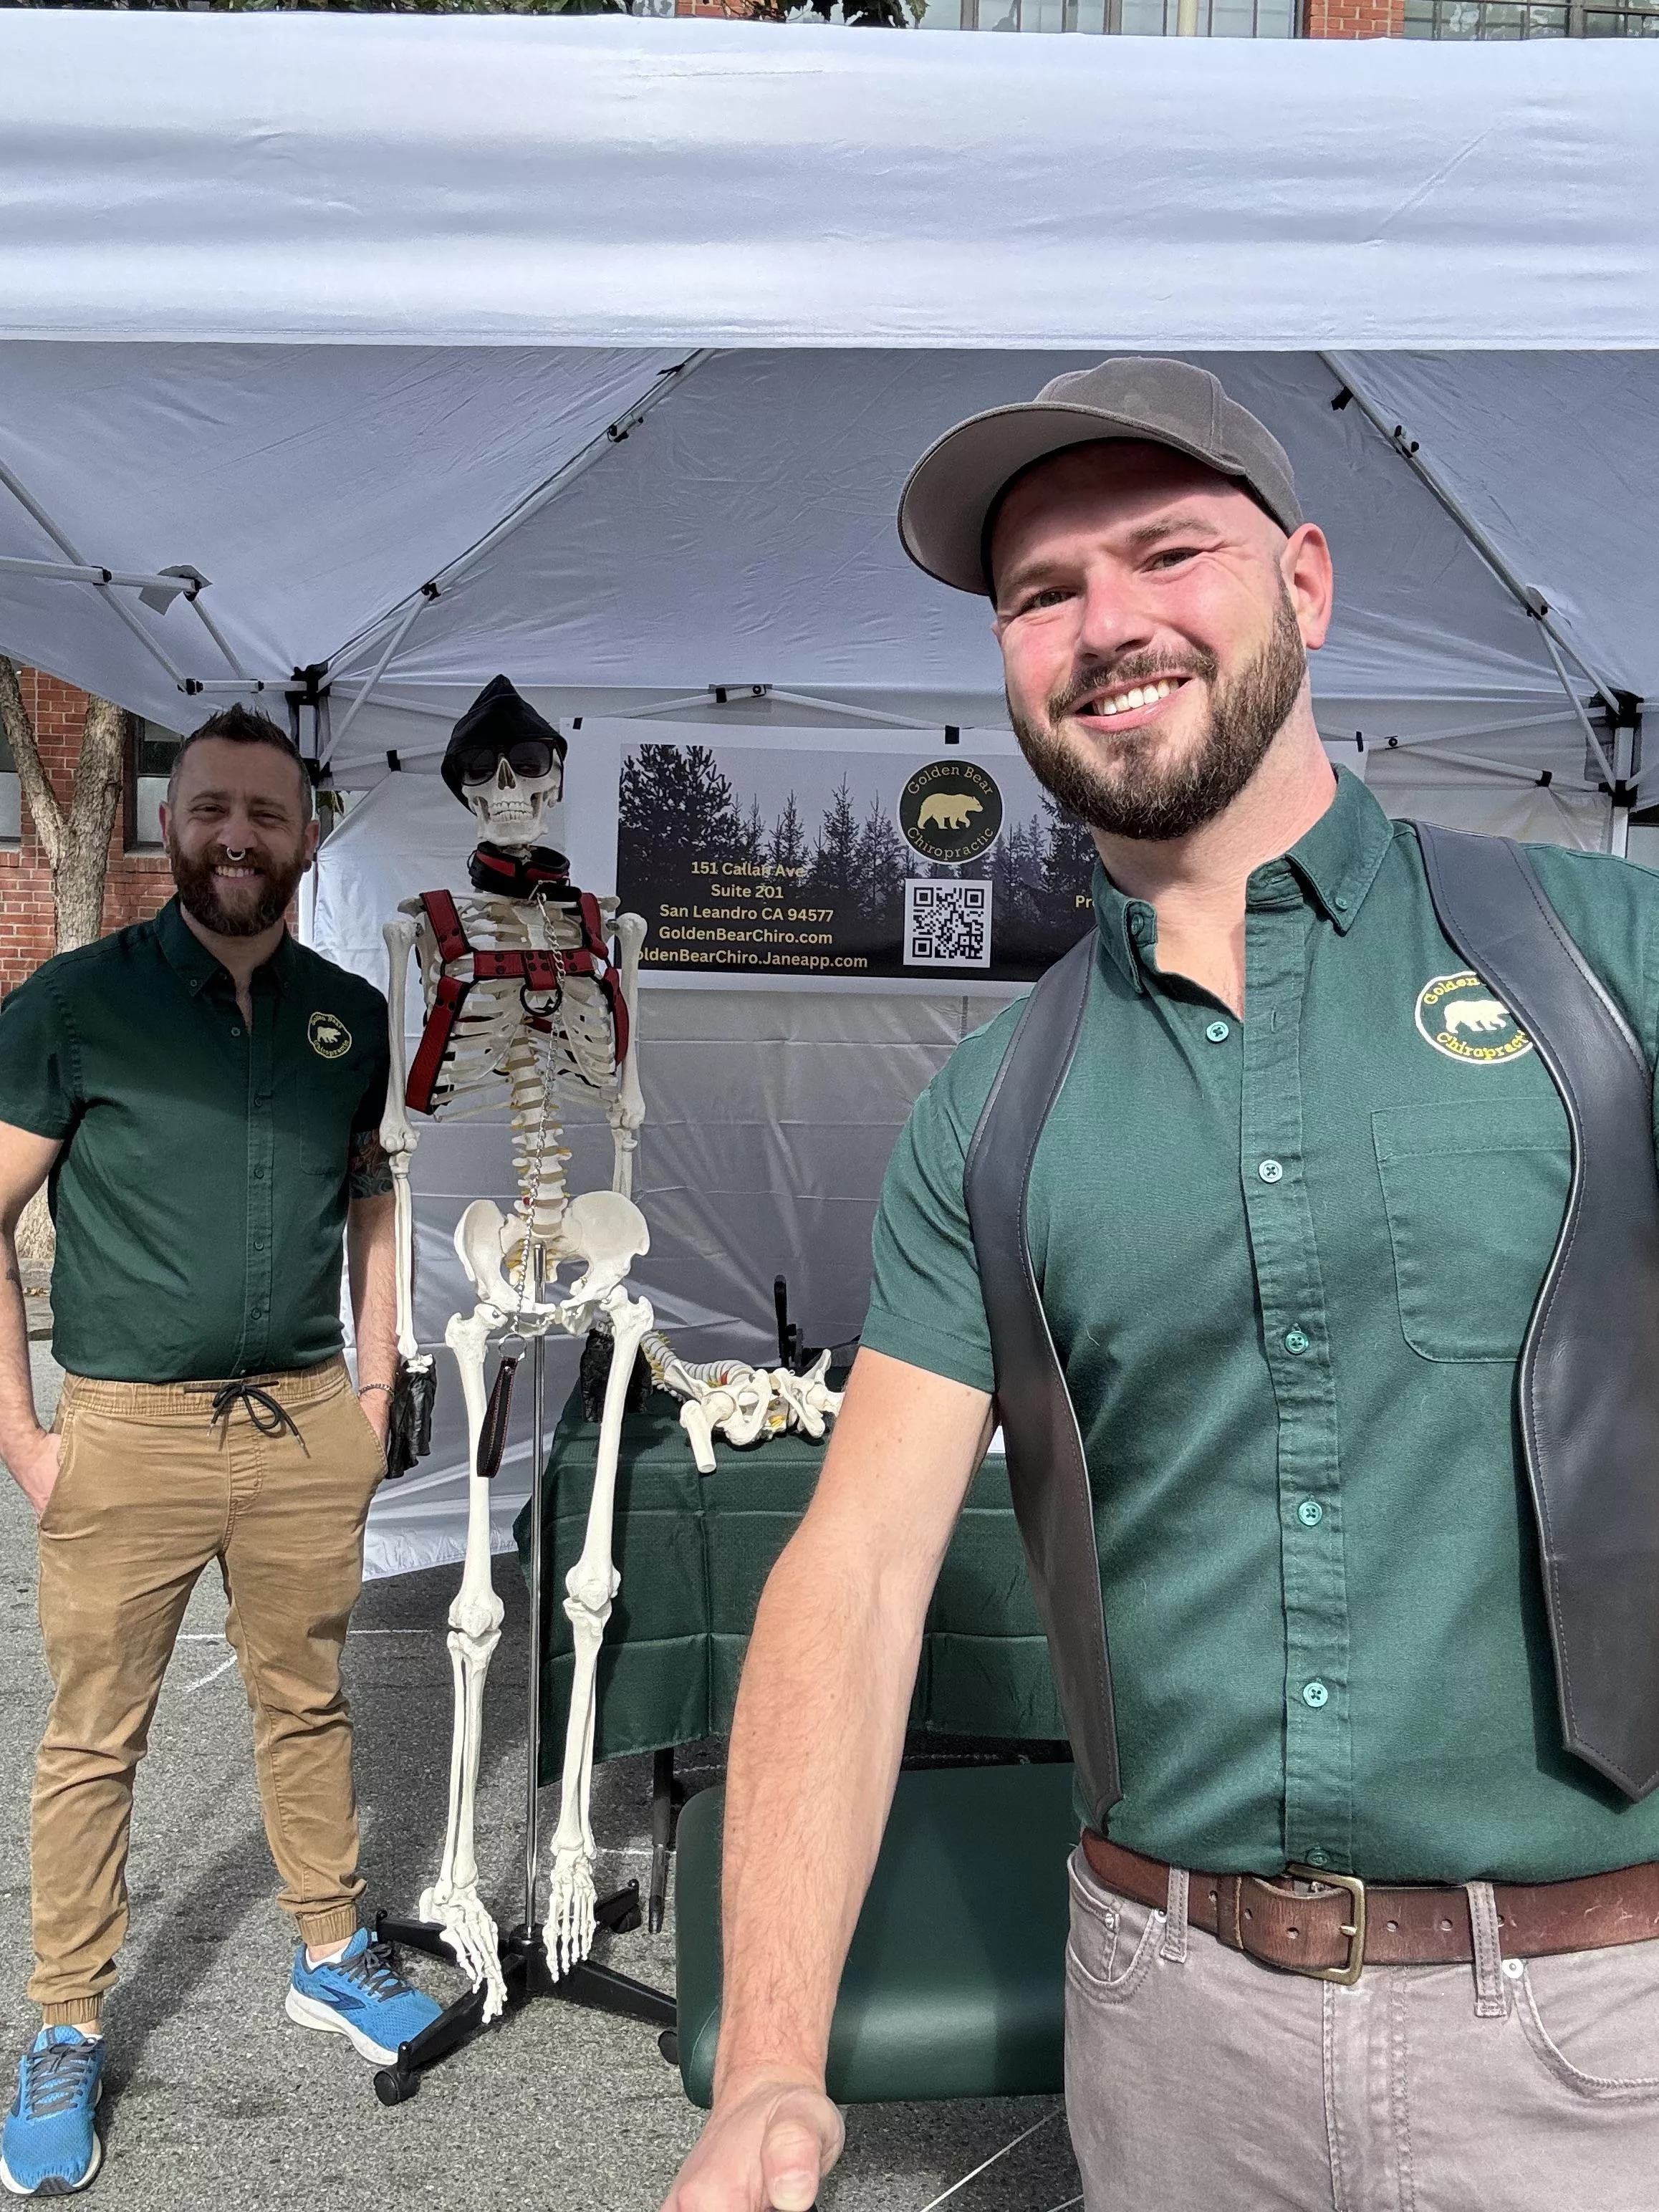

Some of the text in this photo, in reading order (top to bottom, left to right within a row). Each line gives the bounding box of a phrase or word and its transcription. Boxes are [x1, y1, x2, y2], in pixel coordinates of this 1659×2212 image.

[908, 765, 994, 795] Golden Bear
[907, 827, 994, 860] Chiropractic
[691, 861, 807, 877] 151 Callan Ave
[711, 883, 784, 899] Suite 201
[1075, 895, 1095, 908] Pr
[659, 904, 834, 923] San Leandro CA 94577
[658, 925, 833, 945] GoldenBearChiro.com
[638, 948, 868, 969] oldenBearChiro.Janeapp.com
[1423, 977, 1481, 1004] Golden
